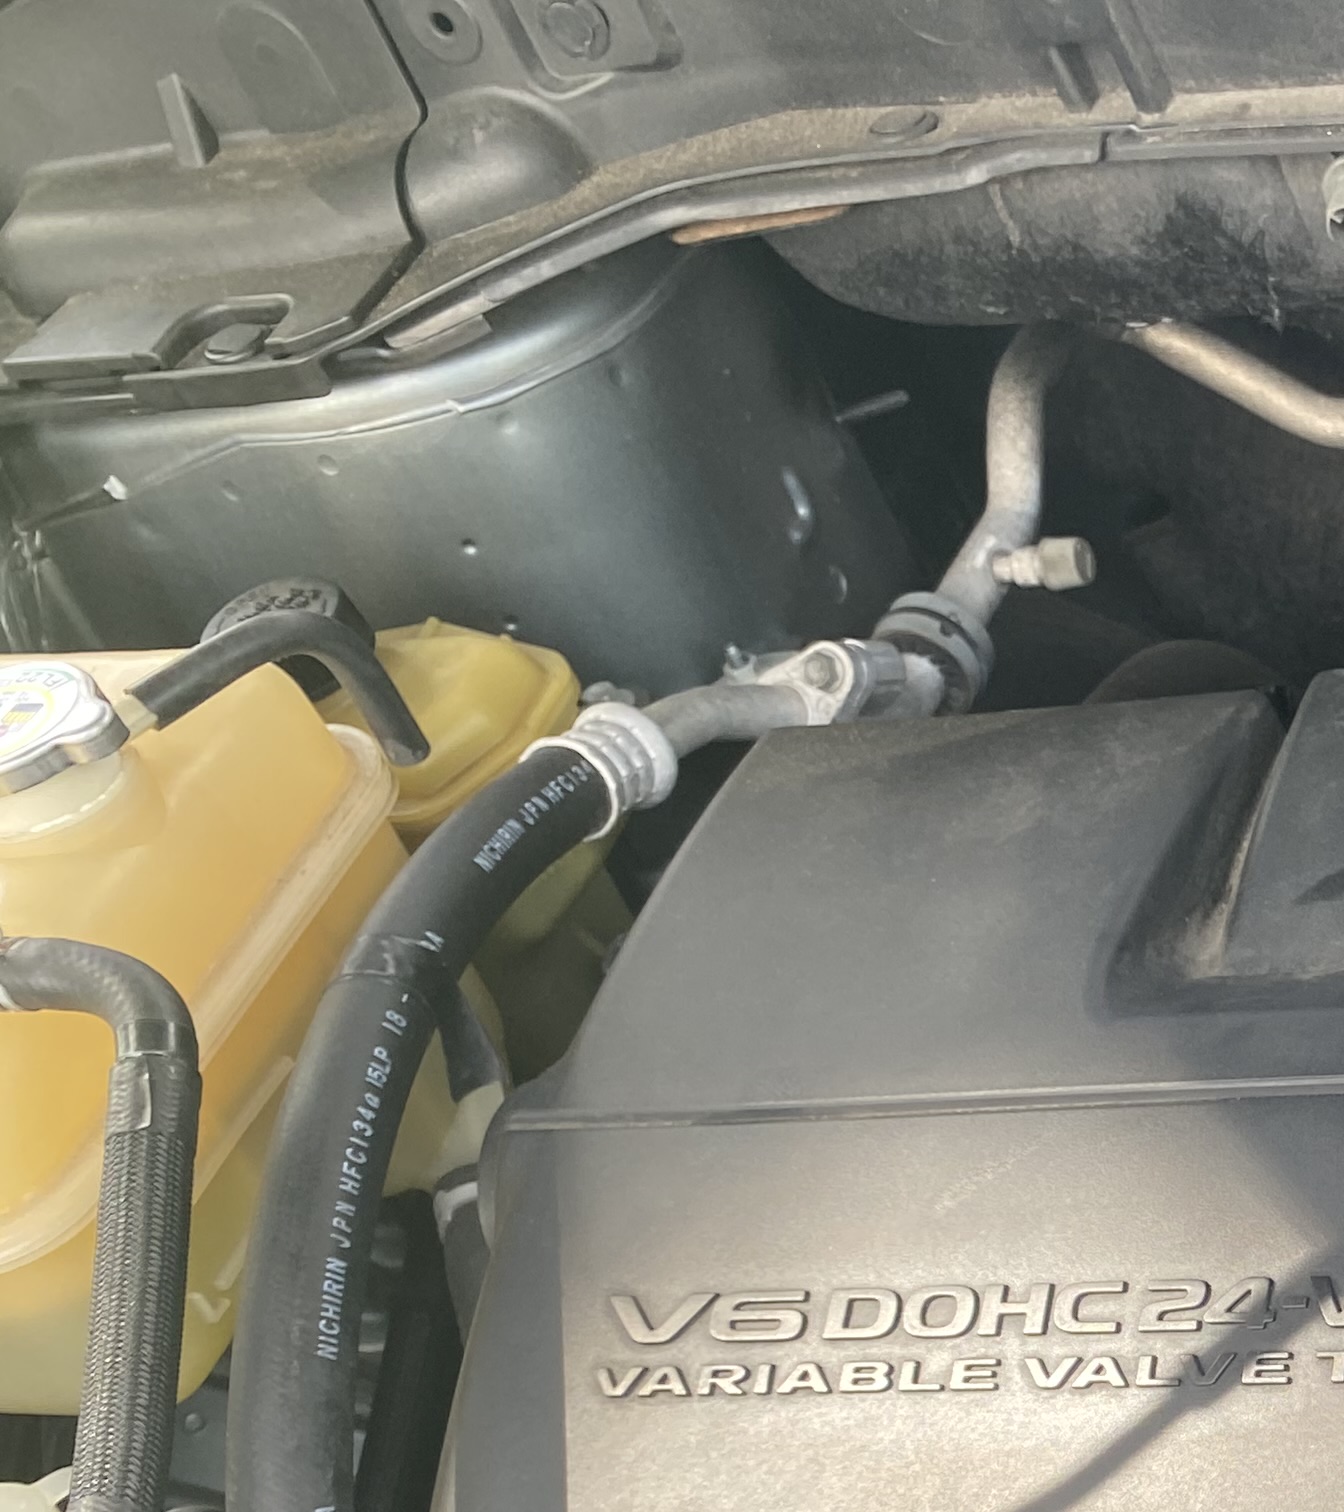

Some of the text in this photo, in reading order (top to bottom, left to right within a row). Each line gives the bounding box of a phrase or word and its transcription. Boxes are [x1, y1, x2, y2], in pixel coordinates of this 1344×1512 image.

[473, 818, 526, 873] NICHIRIN
[519, 796, 550, 825] JPN
[330, 1200, 357, 1249] JPN
[313, 1256, 349, 1361] NICHIRIN
[608, 1288, 812, 1346] V6
[821, 1280, 1129, 1342] DOHC
[597, 1356, 1002, 1399] VARIABLE
[1024, 1350, 1294, 1390] VALVE
